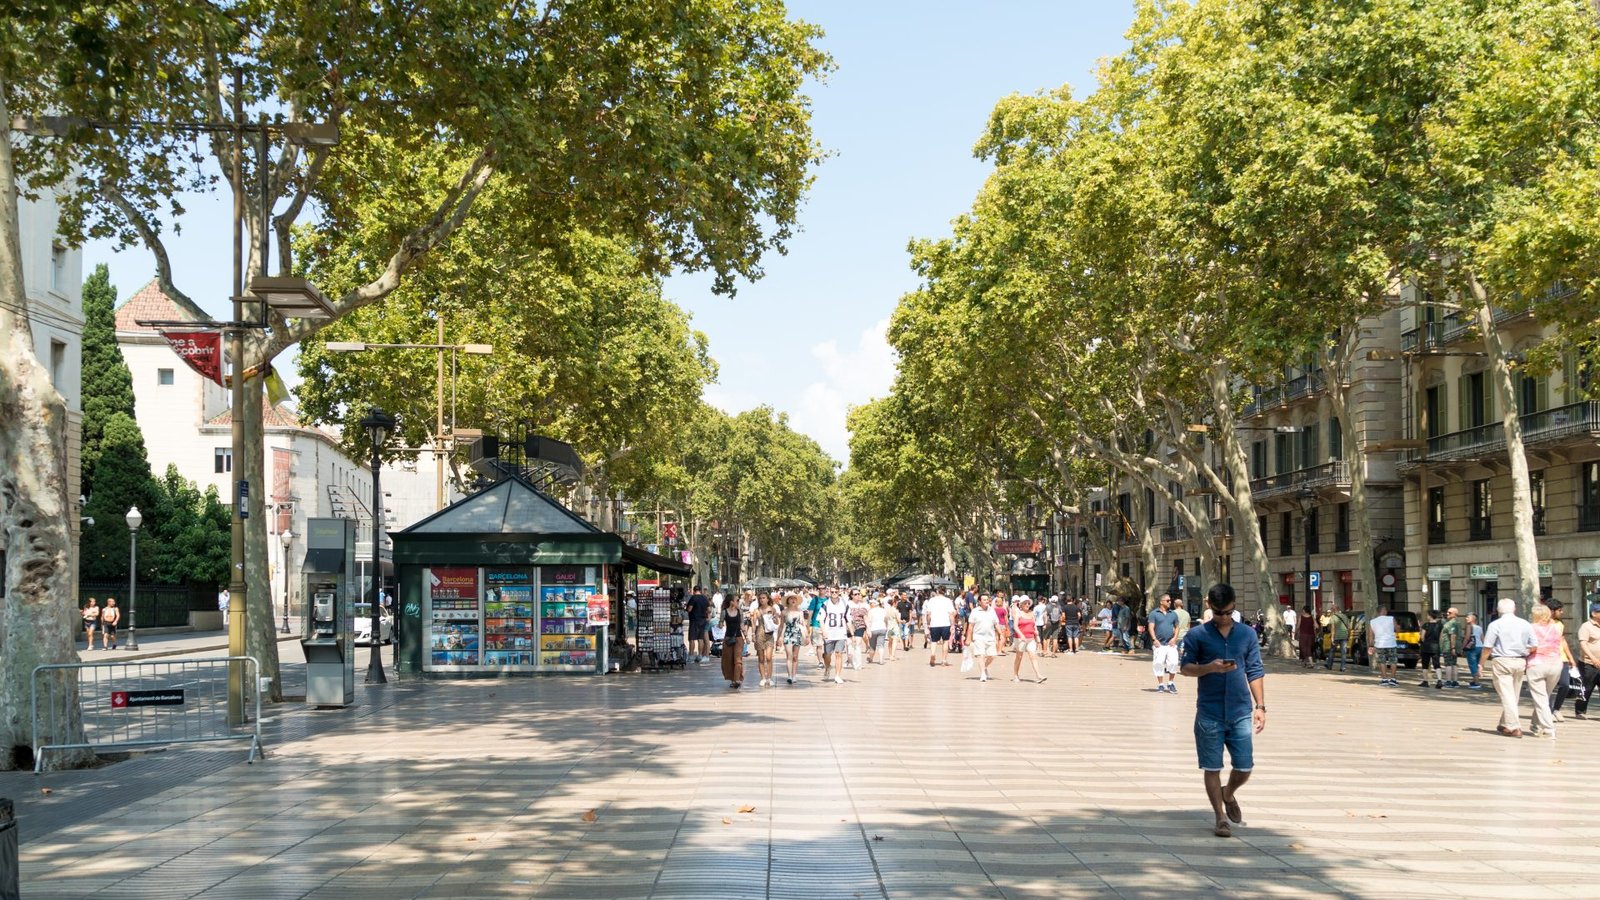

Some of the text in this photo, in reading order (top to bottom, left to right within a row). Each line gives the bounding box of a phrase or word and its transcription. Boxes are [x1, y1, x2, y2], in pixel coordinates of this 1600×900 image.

[1478, 566, 1497, 576] MARKE
[1310, 575, 1317, 586] P
[828, 612, 844, 628] 81
